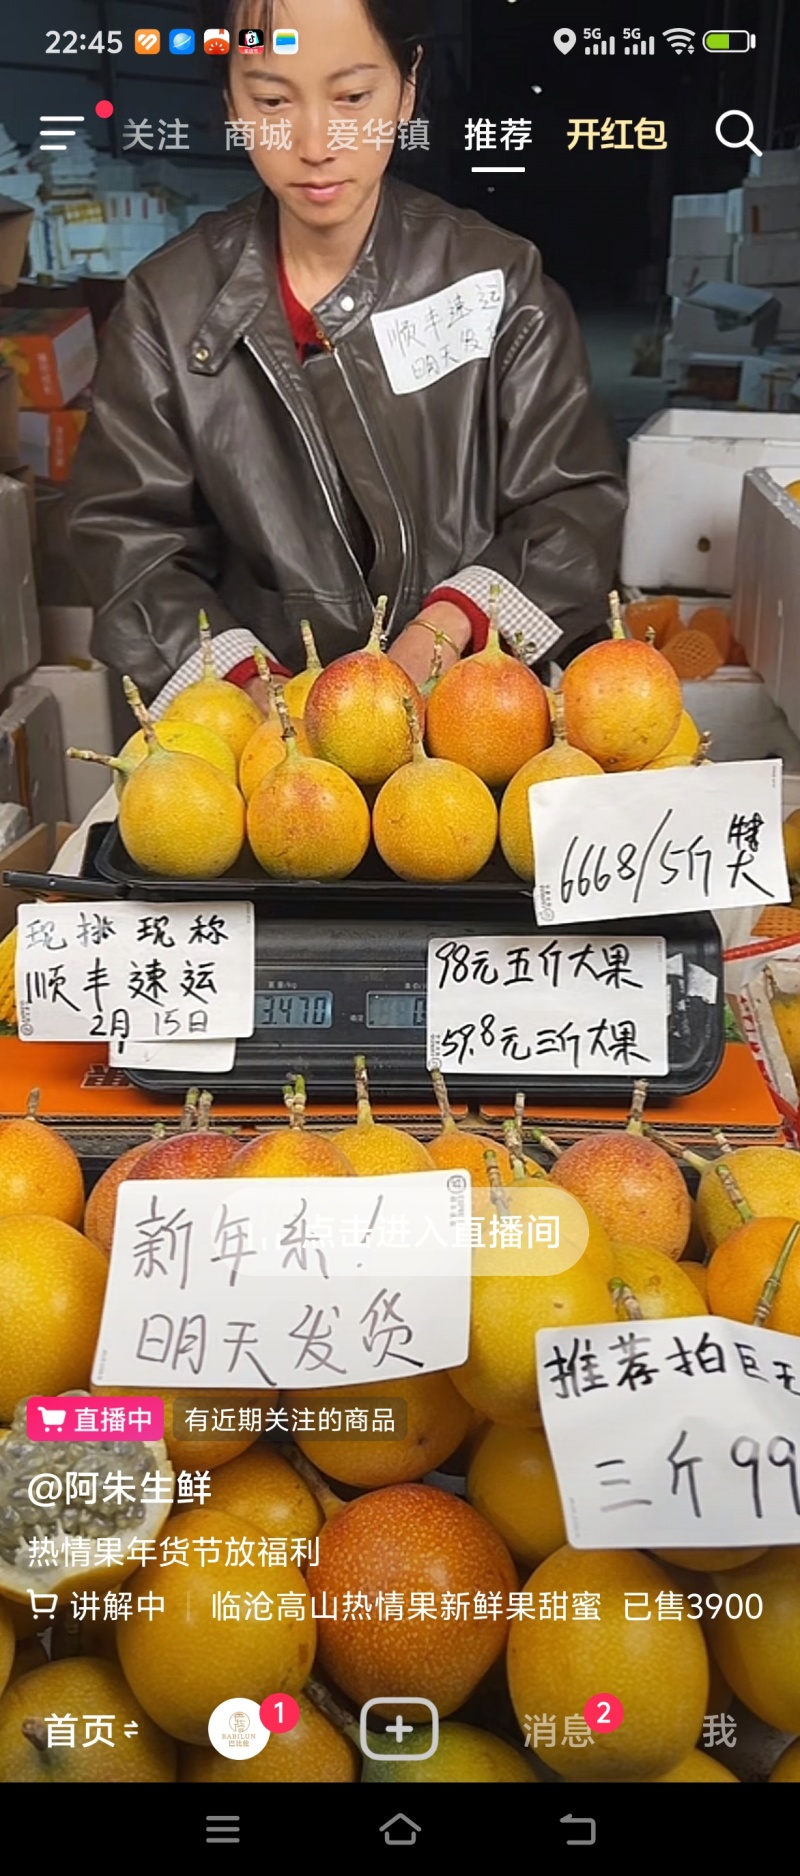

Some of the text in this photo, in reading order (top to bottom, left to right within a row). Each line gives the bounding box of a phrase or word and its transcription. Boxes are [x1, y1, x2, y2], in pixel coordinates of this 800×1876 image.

[26, 957, 218, 1012] 顺丰速运
[435, 940, 644, 990] 98元五斤大果
[90, 1008, 209, 1038] 2月15日
[135, 1288, 425, 1387] 明天发货
